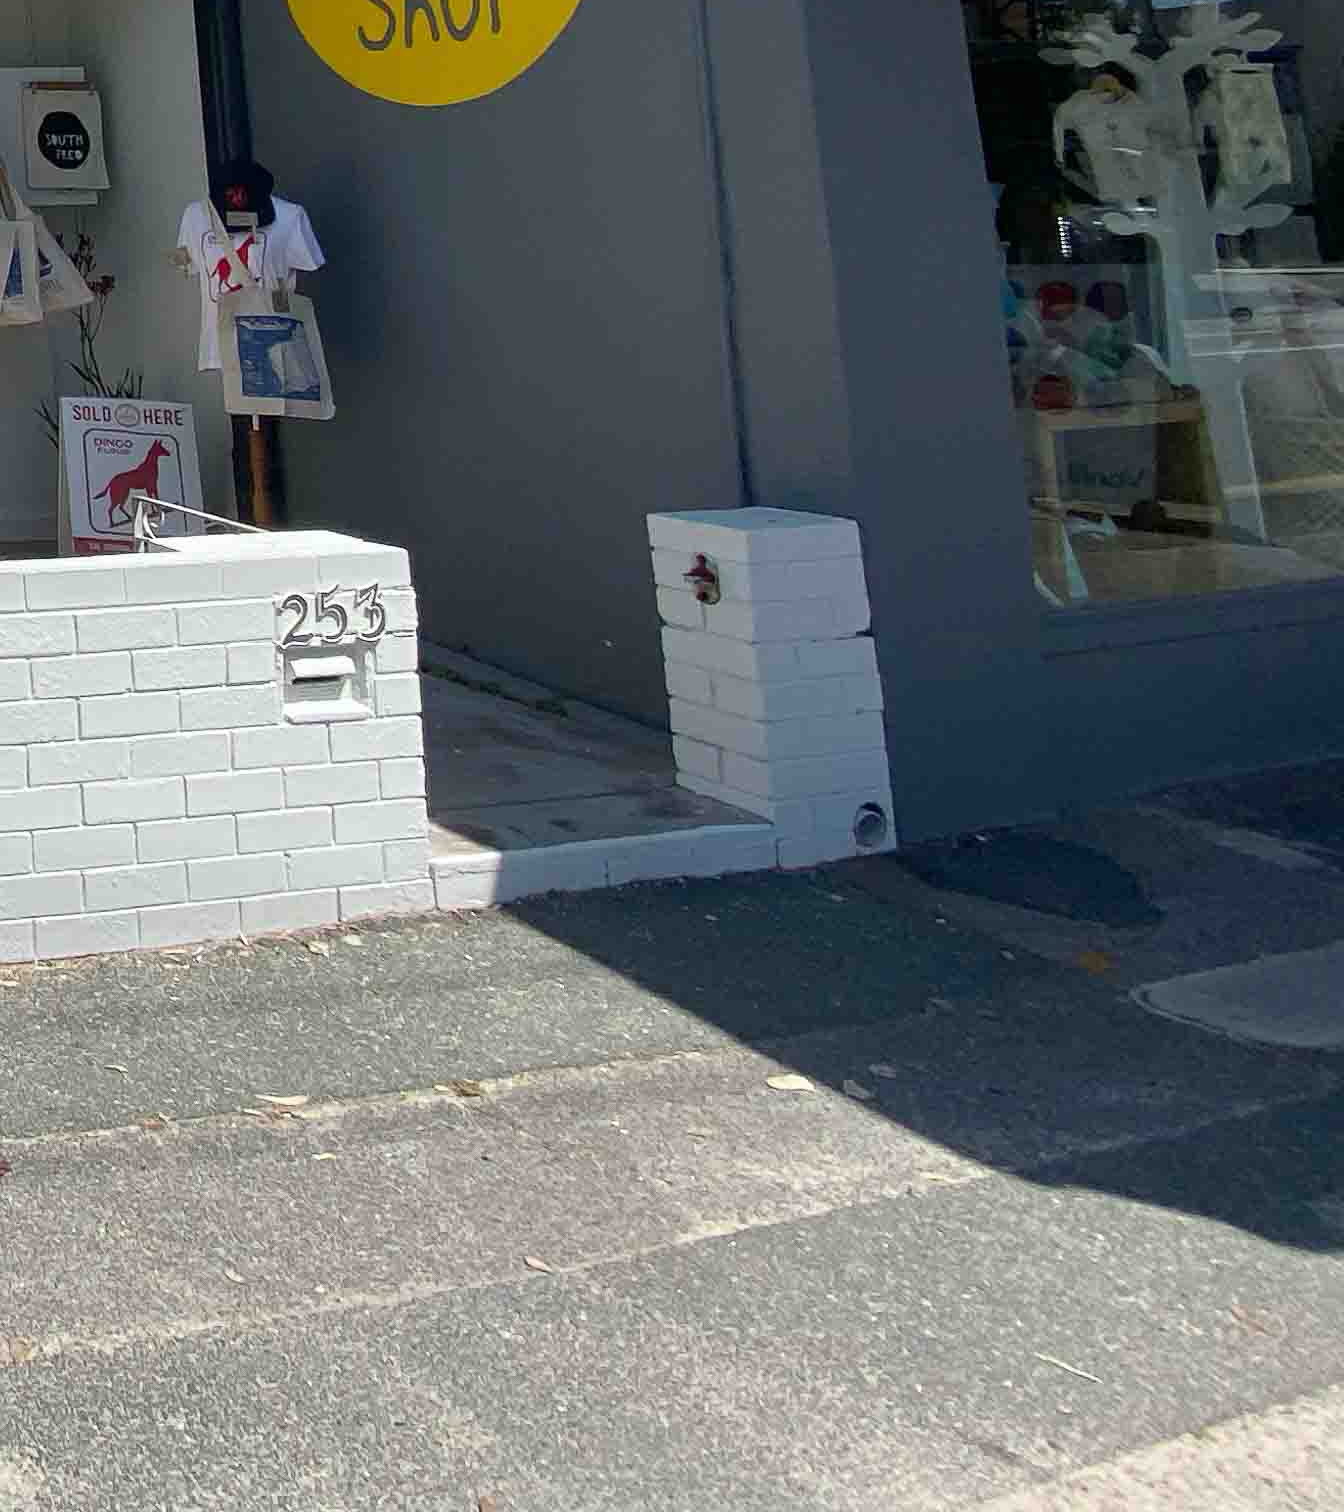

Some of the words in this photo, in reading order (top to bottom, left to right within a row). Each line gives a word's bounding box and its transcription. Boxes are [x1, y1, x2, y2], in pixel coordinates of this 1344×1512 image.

[72, 405, 112, 422] SOLD
[143, 408, 184, 426] HERE
[94, 438, 133, 448] DINGO
[280, 583, 386, 647] 253
